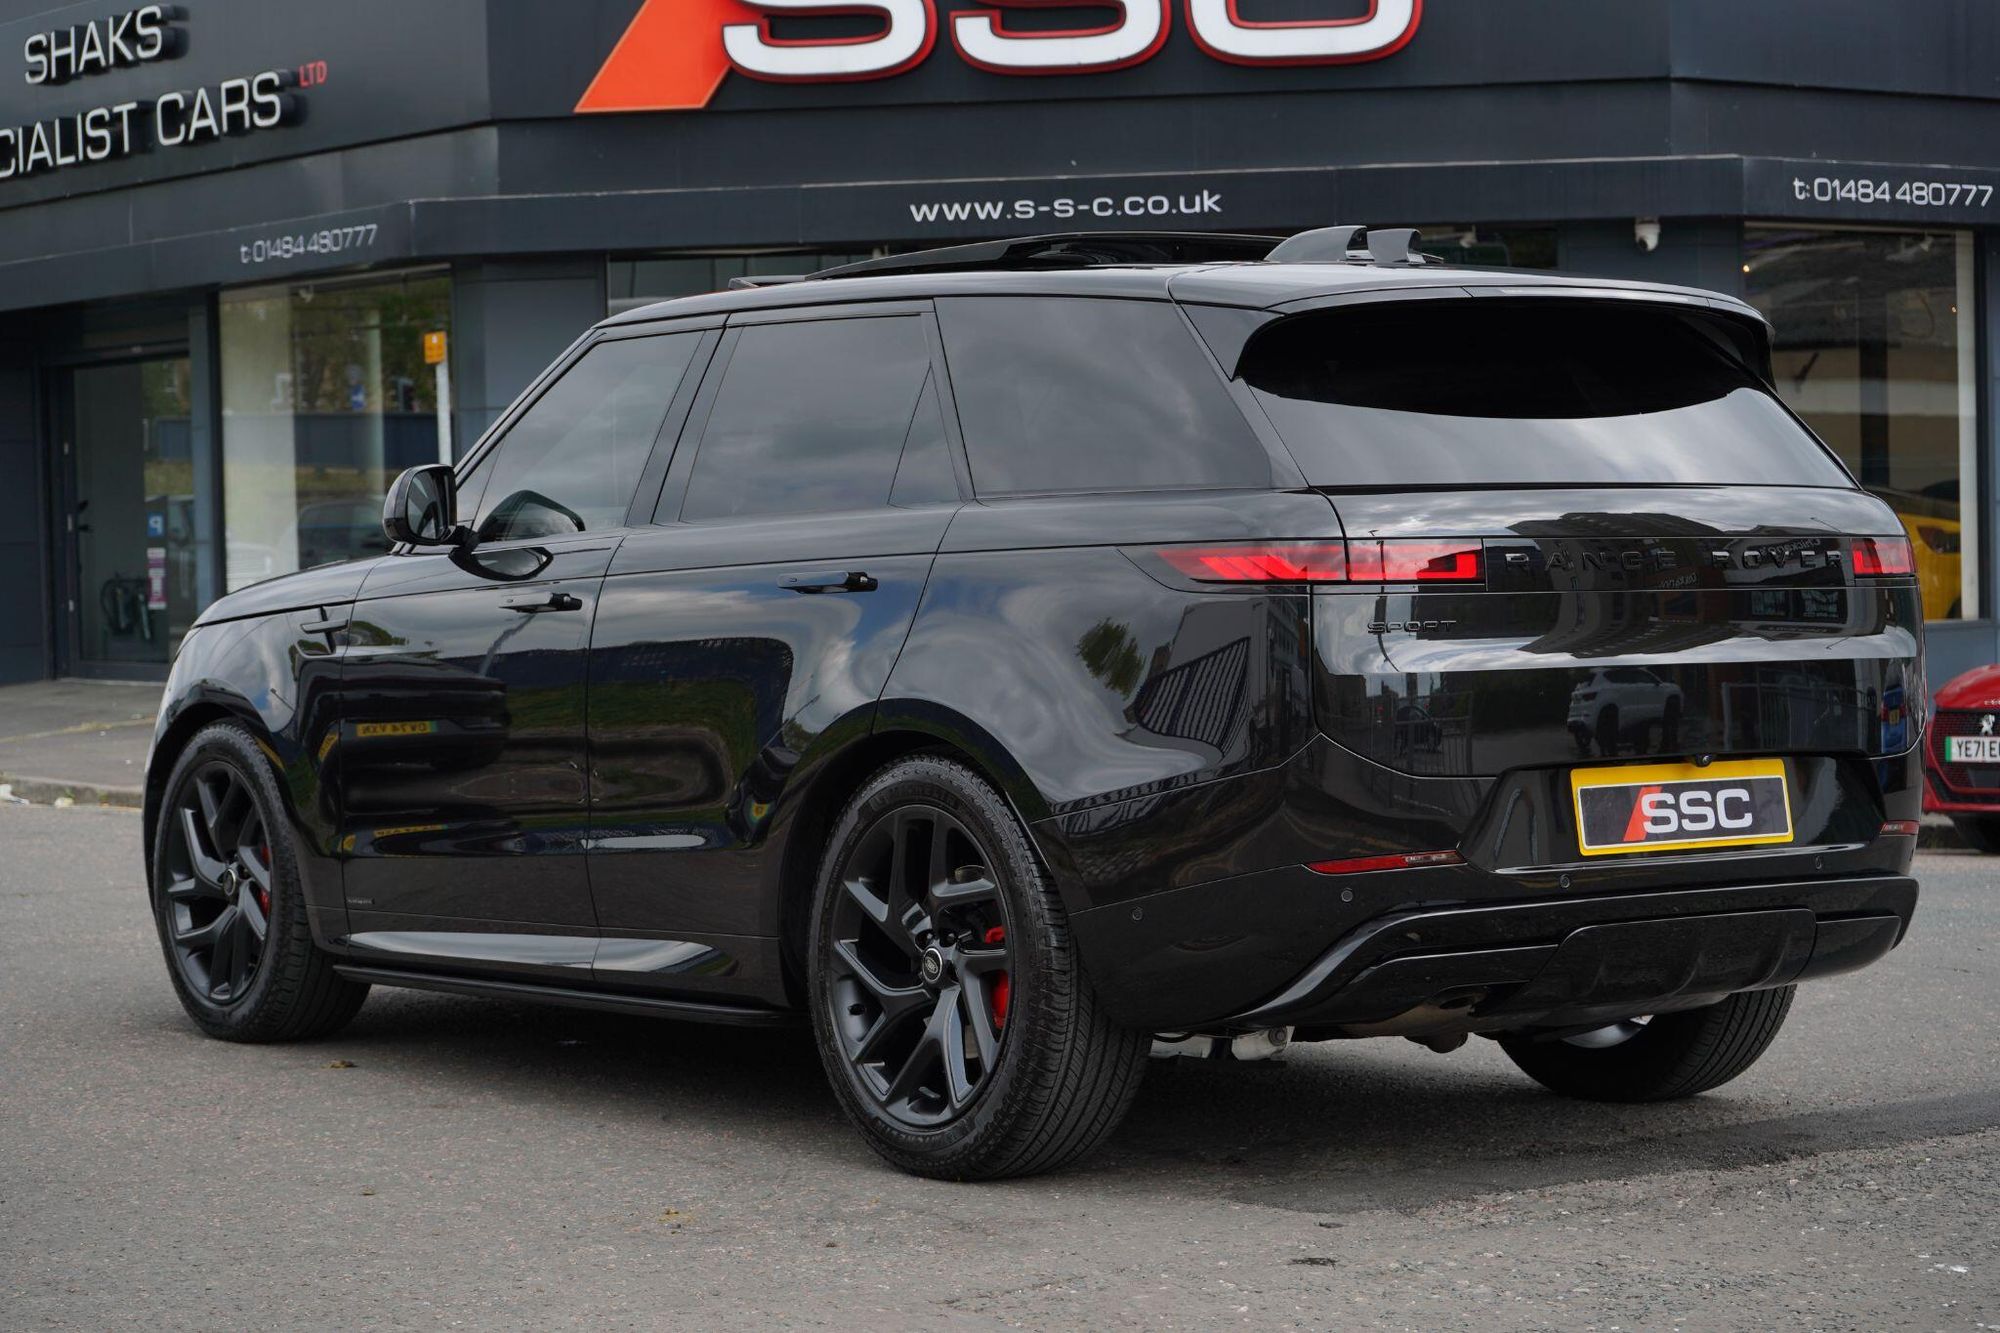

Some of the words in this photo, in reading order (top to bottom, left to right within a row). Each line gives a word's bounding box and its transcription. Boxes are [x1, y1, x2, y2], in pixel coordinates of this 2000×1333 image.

[24, 5, 162, 84] SHAKS
[156, 71, 281, 147] CARS
[299, 60, 327, 89] LTD
[909, 189, 1223, 222] www.s-s-c.co.uk
[1894, 181, 1994, 207] 480777
[1505, 551, 1676, 571] RANGE
[1712, 550, 1841, 570] ROVER
[1367, 620, 1456, 634] SPORT
[1989, 740, 2000, 758] E
[1641, 788, 1753, 834] SSC
